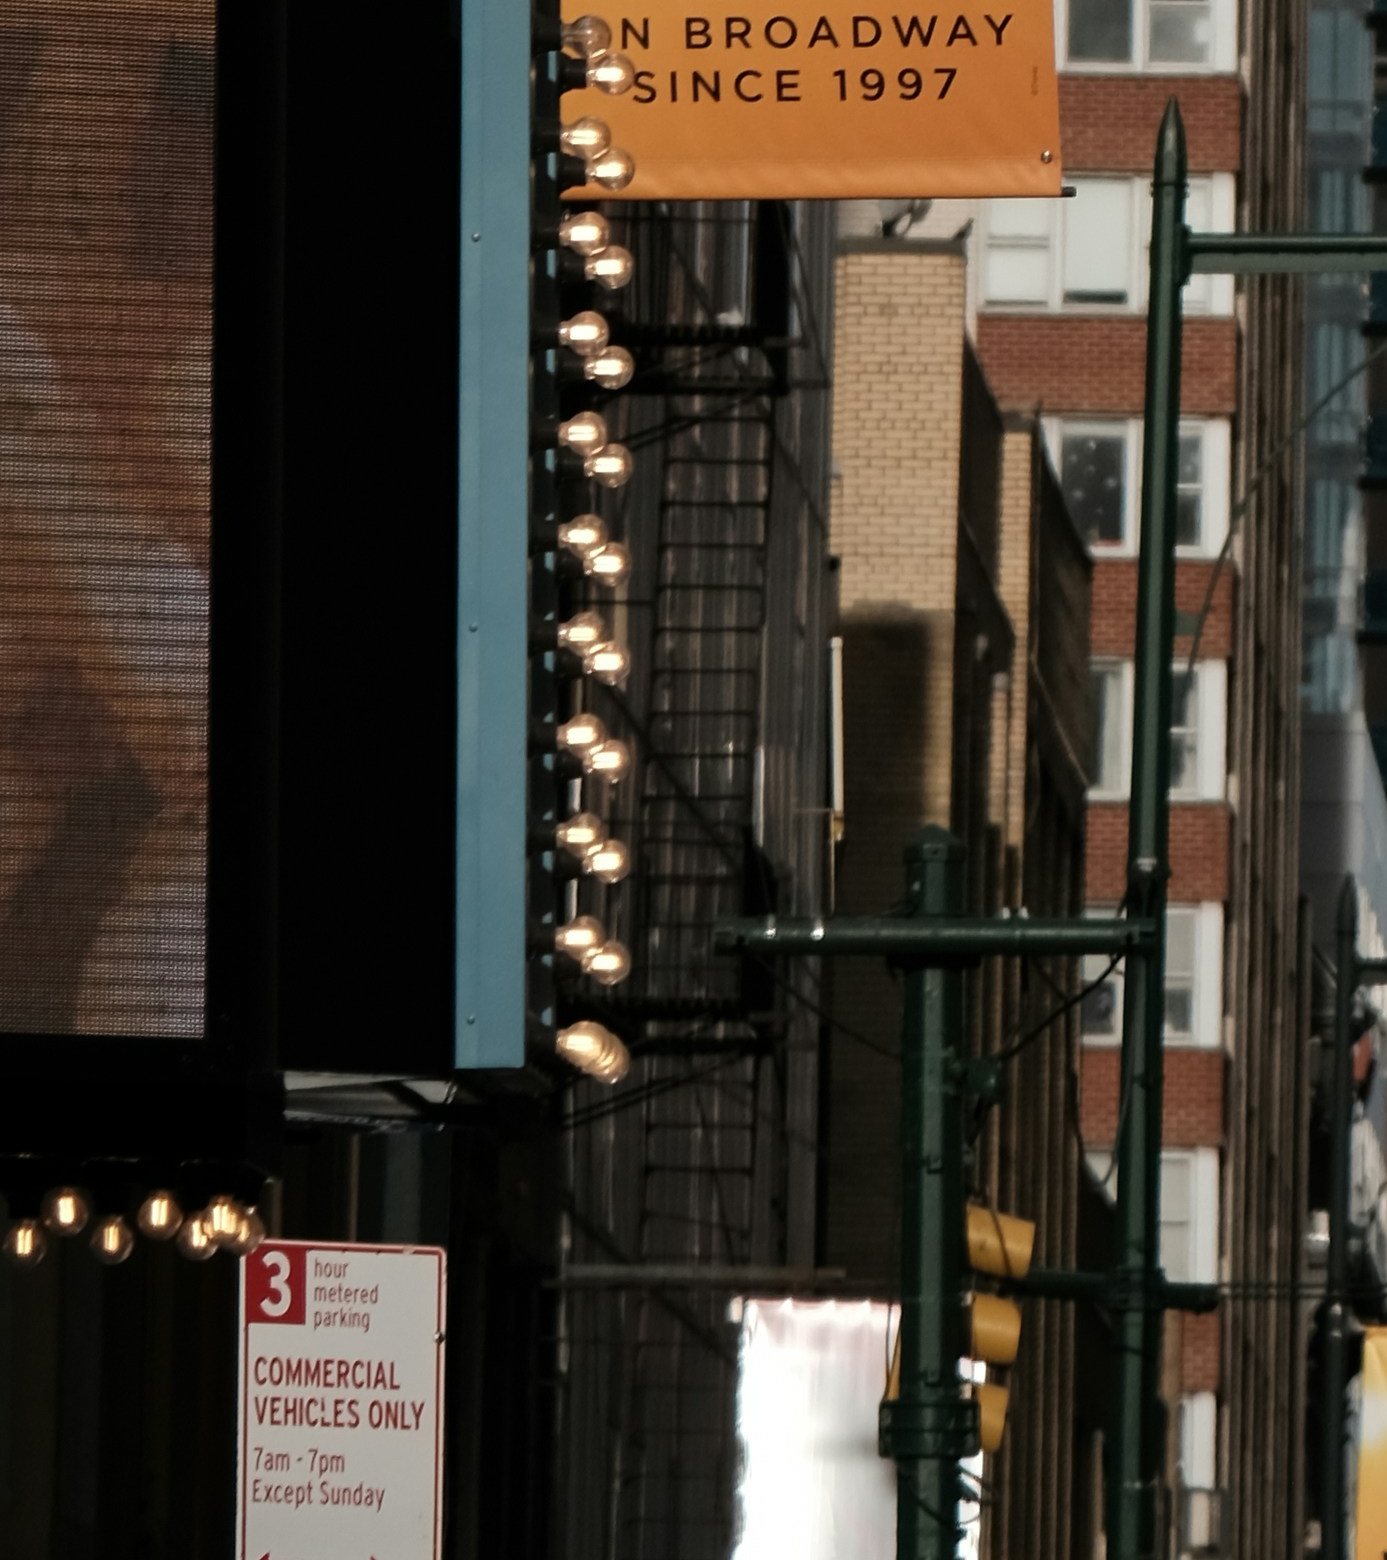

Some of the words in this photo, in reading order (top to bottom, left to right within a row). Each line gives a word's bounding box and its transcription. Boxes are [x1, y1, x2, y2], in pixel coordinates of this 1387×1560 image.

[685, 13, 1014, 51] BROADWAY
[632, 68, 801, 104] SINCE
[833, 67, 958, 103] 1997
[259, 1250, 292, 1318] 3
[314, 1257, 349, 1279] hour
[314, 1284, 379, 1305] metered
[313, 1308, 371, 1333] parking
[254, 1355, 400, 1390] COMMERCIAL
[254, 1396, 360, 1429] VEHICLES
[368, 1399, 425, 1431] ONLY
[253, 1446, 290, 1473] 7am
[308, 1448, 345, 1479] 7pm
[252, 1478, 314, 1510] Except
[319, 1481, 386, 1514] Sunday
